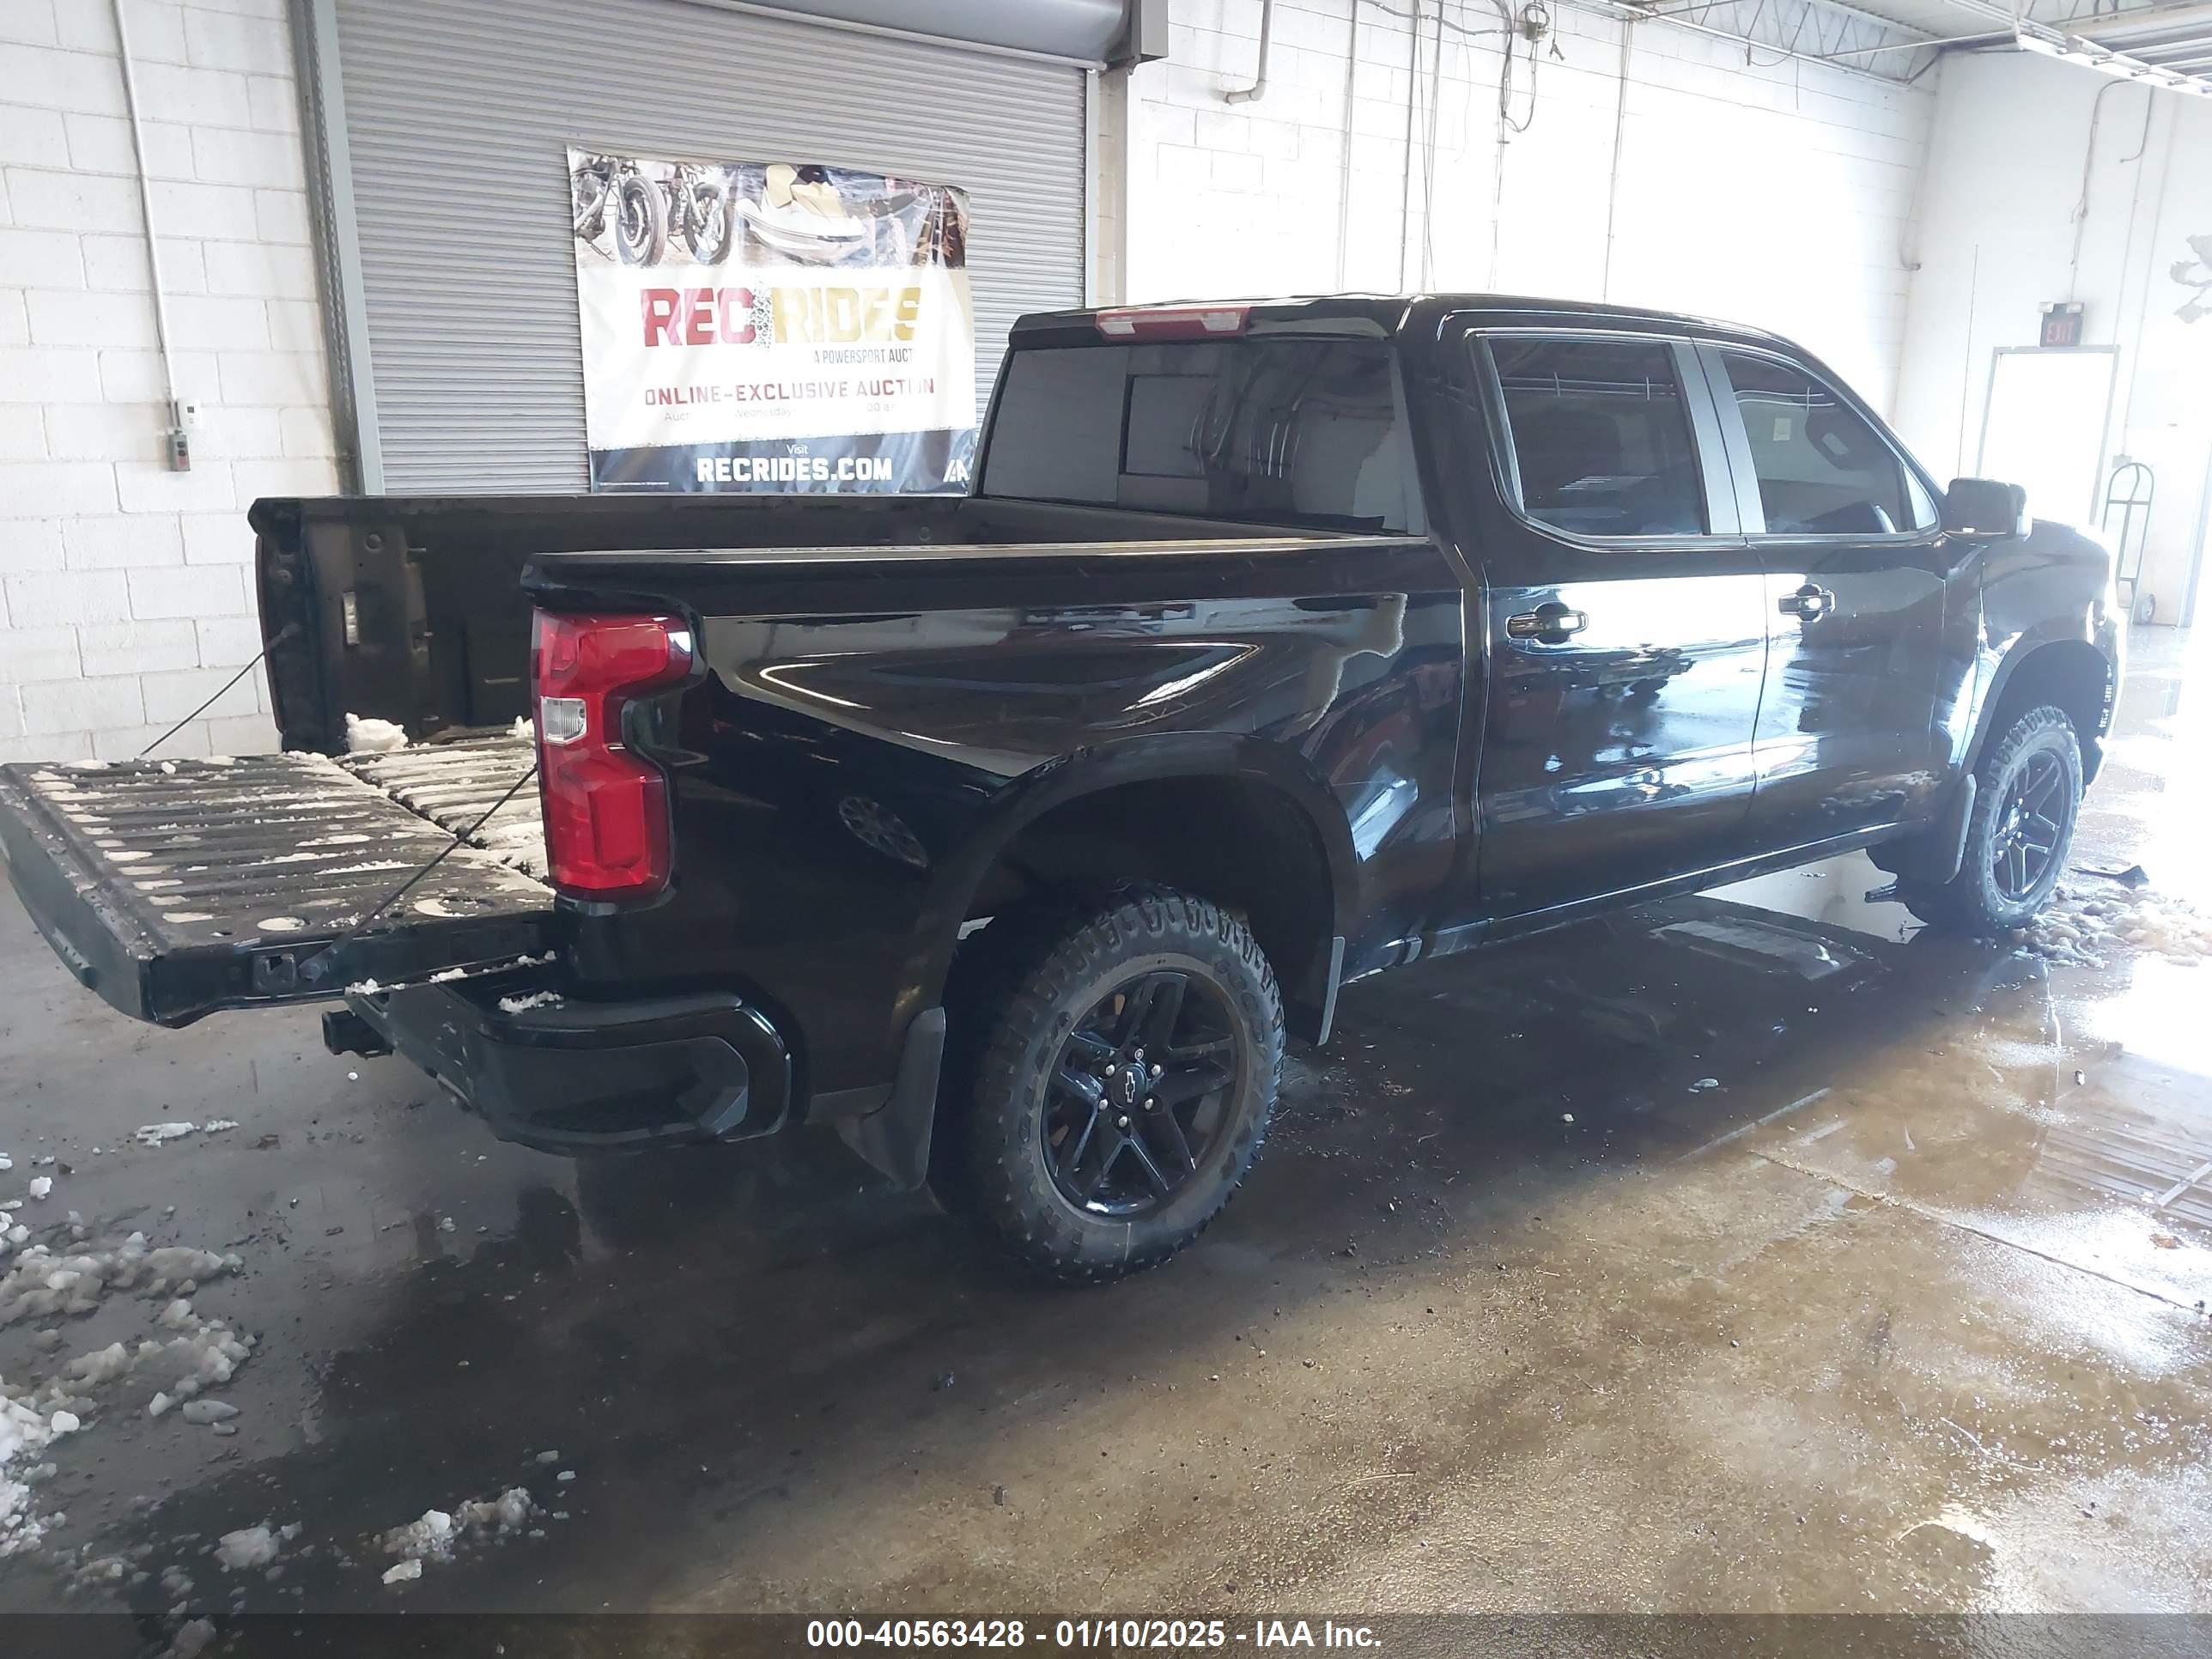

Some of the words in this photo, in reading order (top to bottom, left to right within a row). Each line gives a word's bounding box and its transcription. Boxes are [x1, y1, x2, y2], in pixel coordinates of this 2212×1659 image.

[640, 288, 756, 347] REC
[770, 287, 921, 344] RIDES
[2045, 321, 2074, 344] EXIT
[812, 349, 821, 365] A
[823, 348, 886, 365] POWERSPORT
[644, 380, 848, 407] ONLINE-EXCLUSIVE
[786, 444, 809, 456] Visit
[696, 457, 893, 483] RECRIDES.COM
